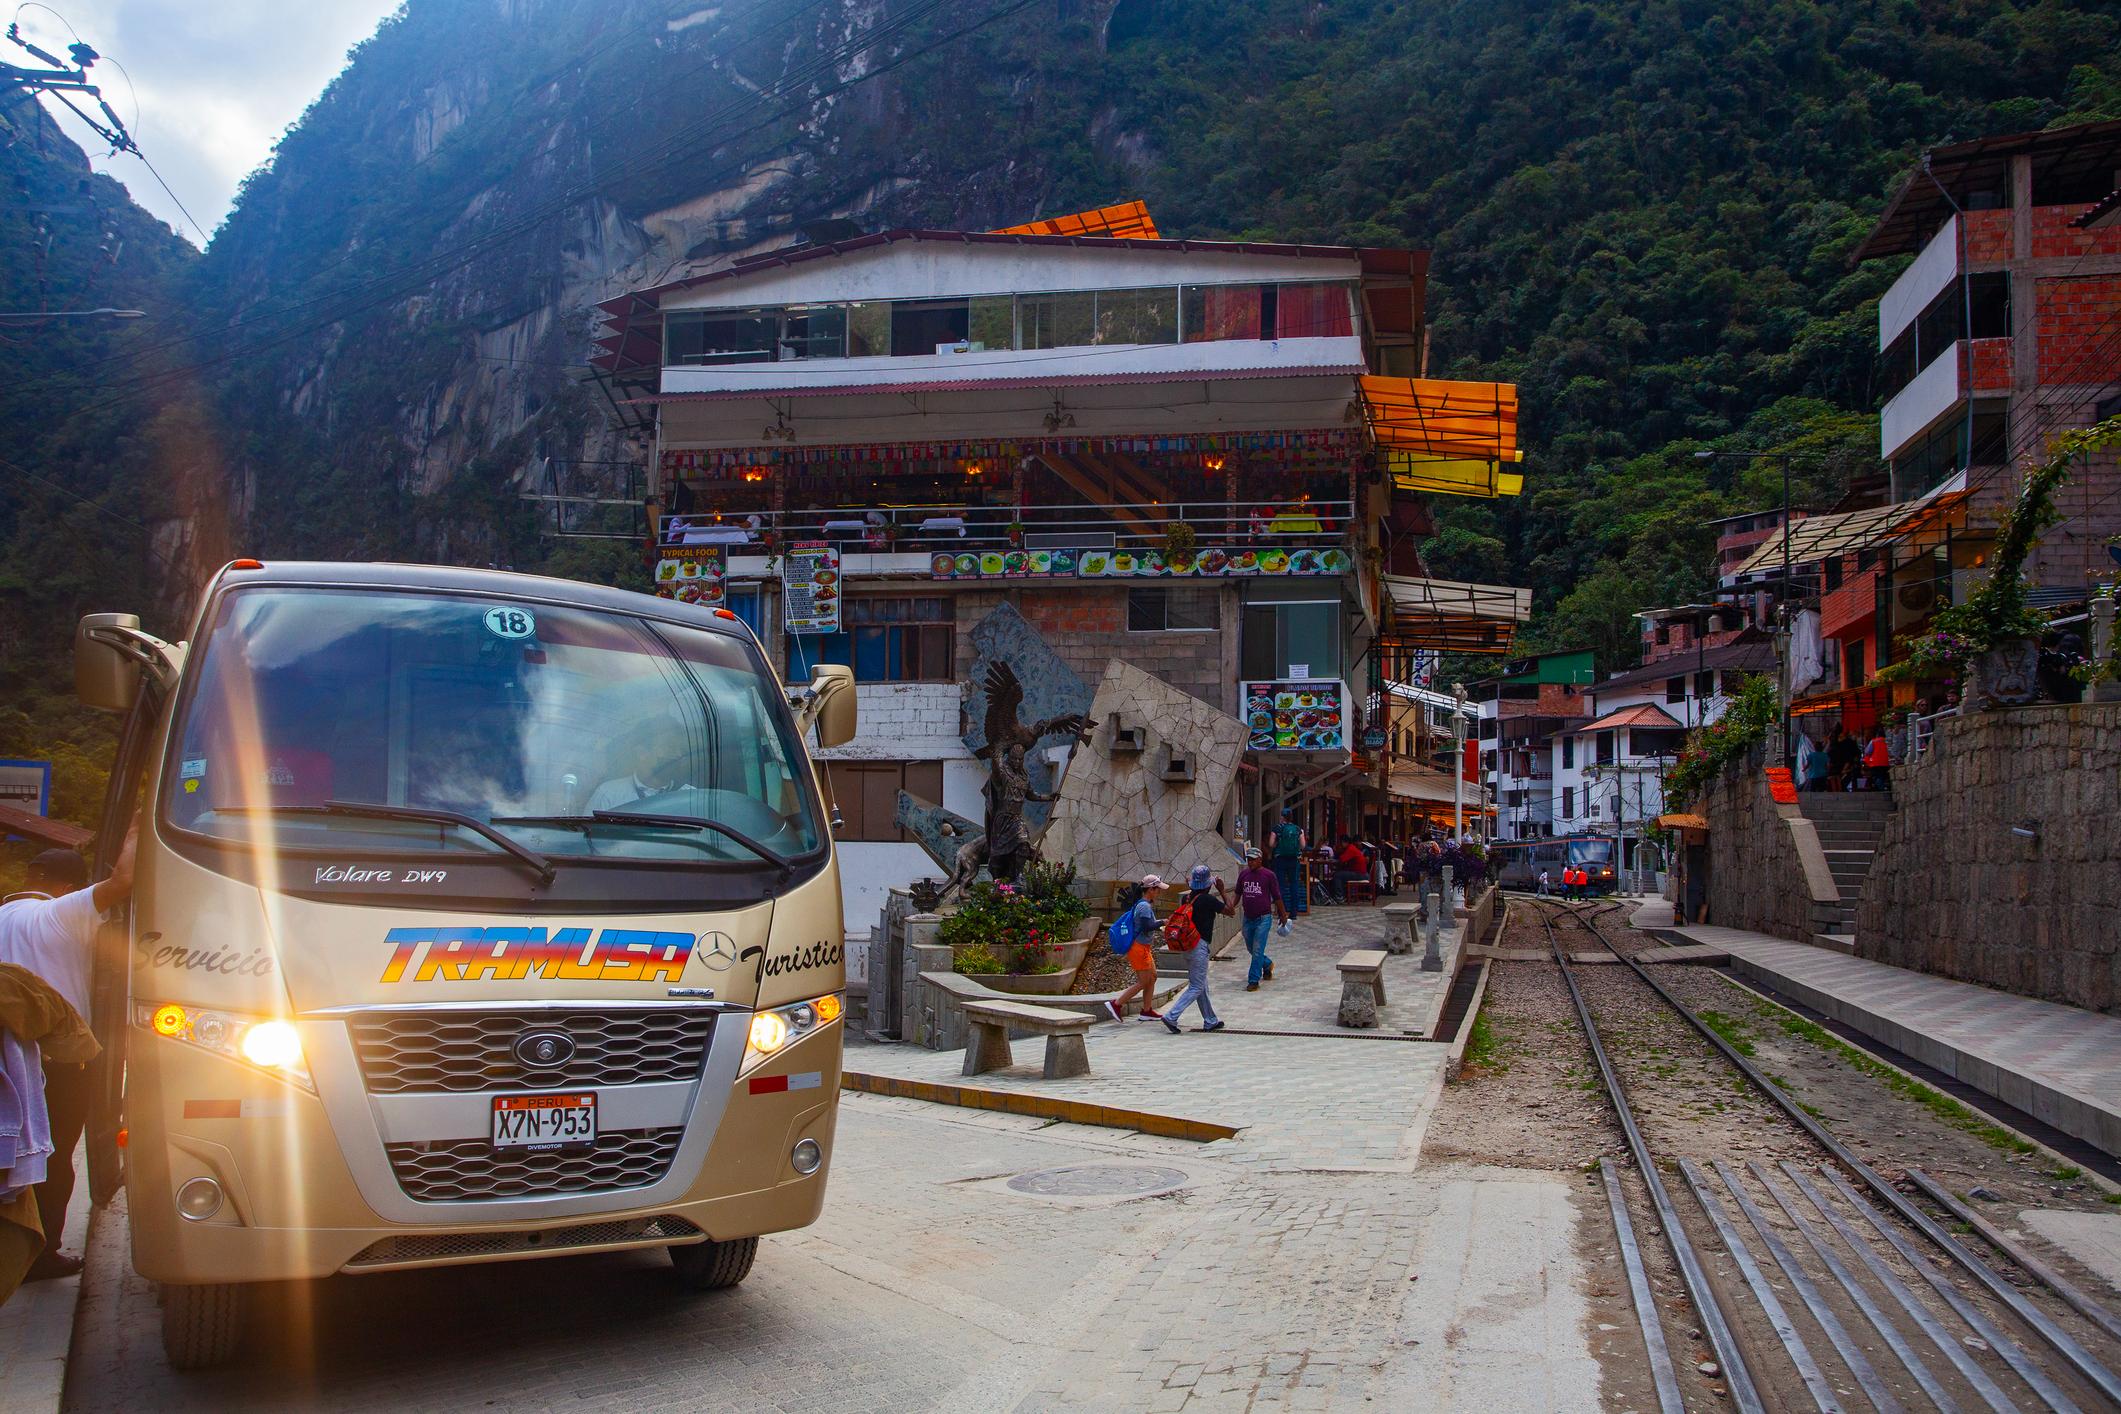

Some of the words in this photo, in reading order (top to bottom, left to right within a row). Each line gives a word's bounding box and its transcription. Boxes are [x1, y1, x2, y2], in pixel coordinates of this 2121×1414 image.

[661, 548, 695, 557] TYPICAL
[696, 548, 719, 557] FOOD
[492, 611, 528, 634] 18
[315, 865, 393, 884] Volare
[401, 870, 447, 883] DW9
[134, 931, 275, 977] Servicio
[380, 927, 696, 983] TRAMUSA
[527, 1098, 563, 1109] PERU
[498, 1107, 592, 1139] X7N-953
